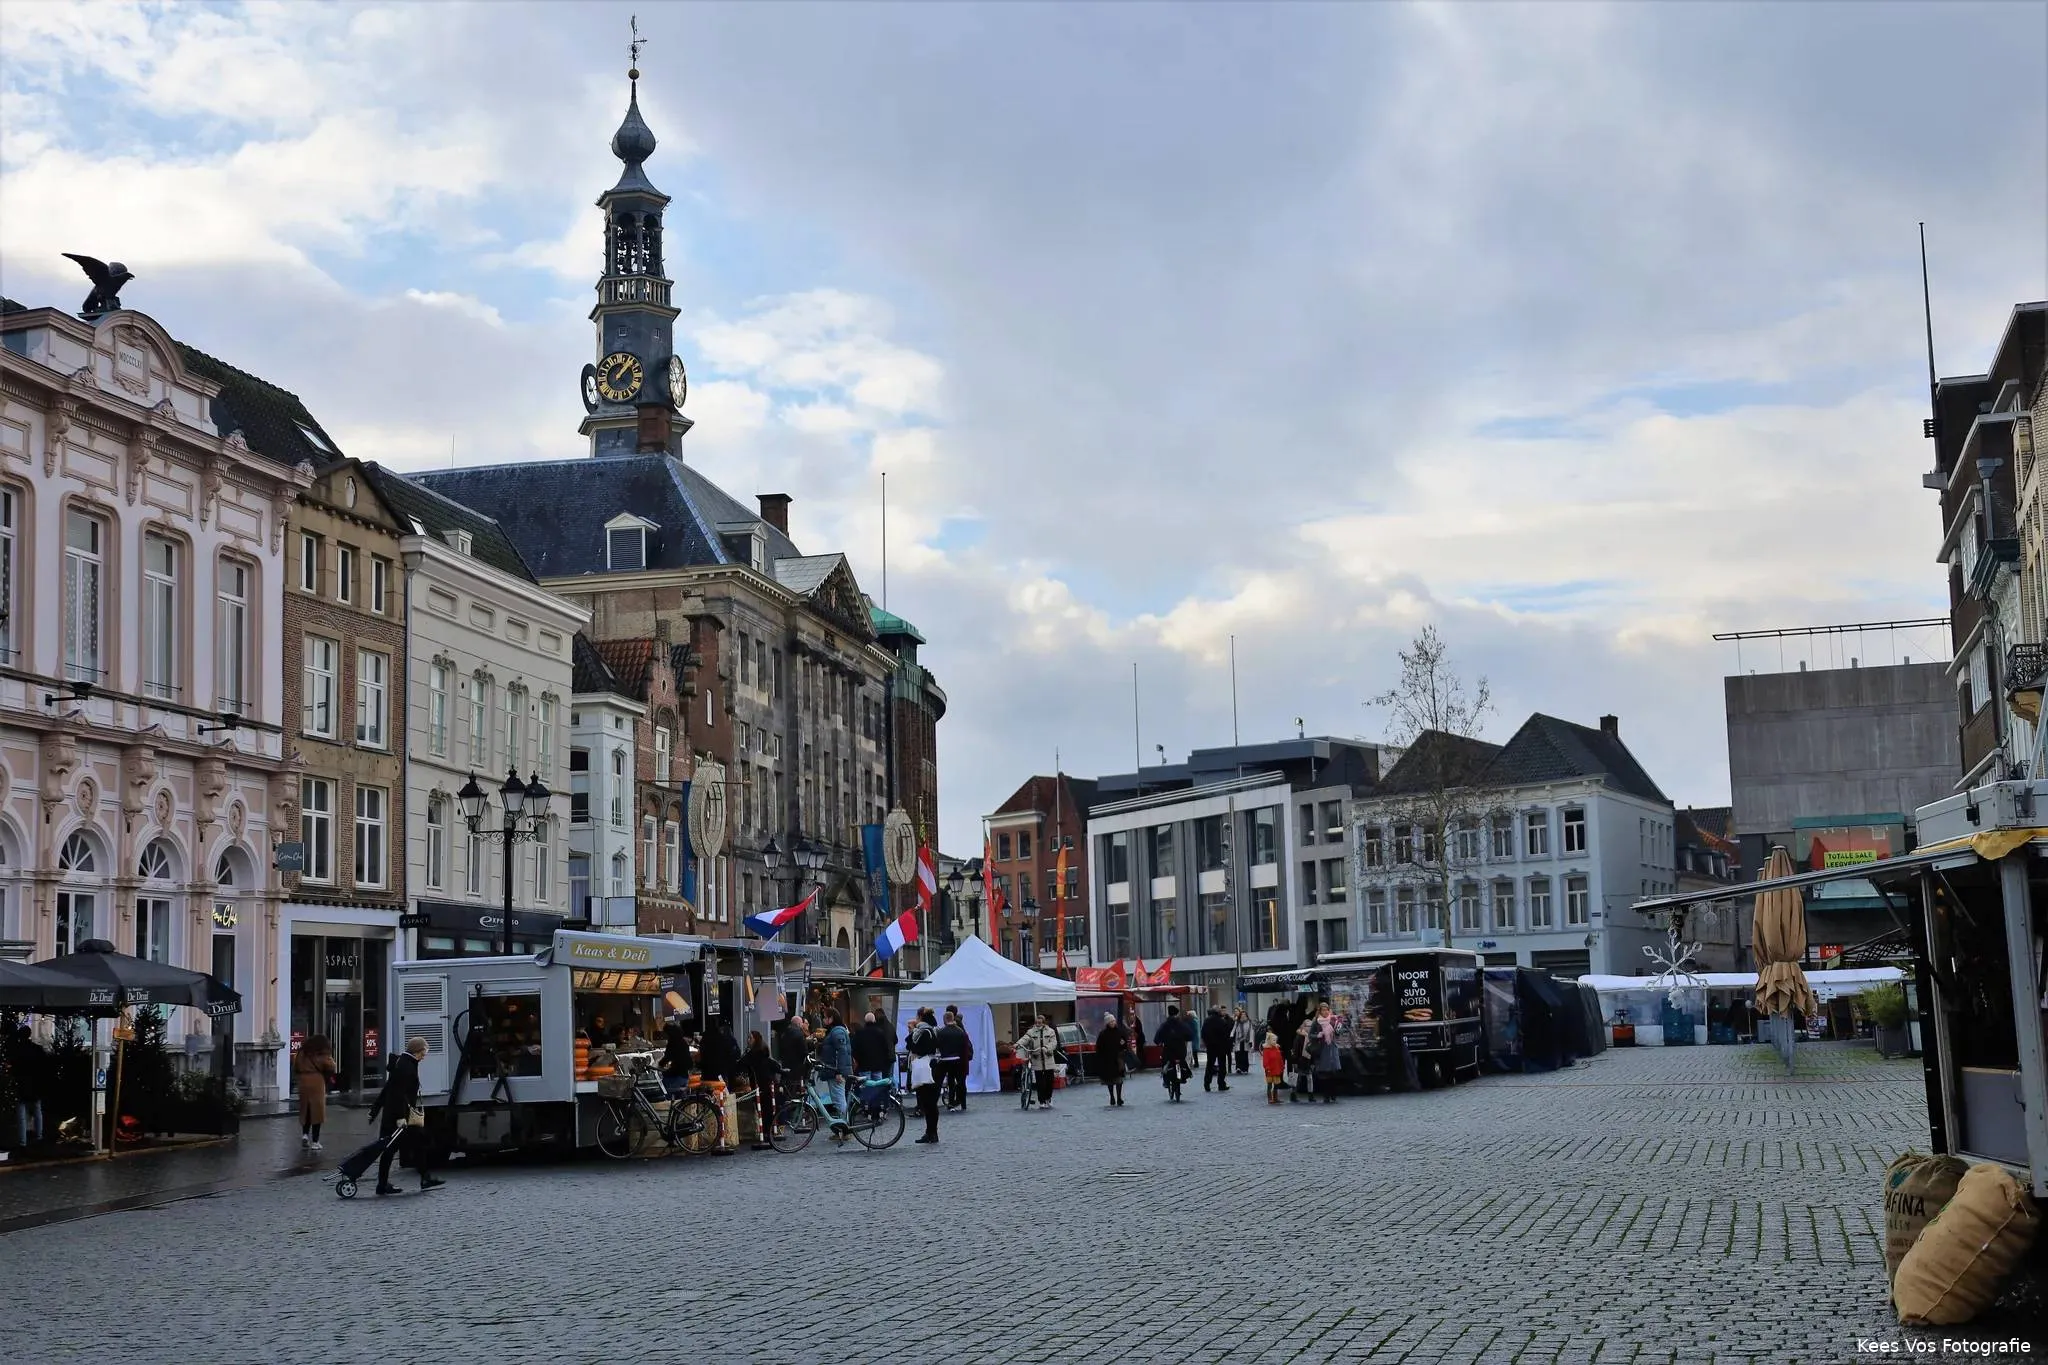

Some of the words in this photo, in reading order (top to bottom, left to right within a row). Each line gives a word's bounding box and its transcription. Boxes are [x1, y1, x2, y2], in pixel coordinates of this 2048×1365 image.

[1855, 851, 1873, 859] SALE
[575, 943, 605, 955] Kaas
[608, 948, 616, 958] &
[622, 948, 647, 961] Deli
[1398, 971, 1429, 980] NOORT
[1209, 977, 1225, 985] ZARA
[1411, 980, 1418, 988] &
[1404, 988, 1426, 997] SUYD
[1400, 997, 1430, 1006] NOTEN
[212, 1001, 237, 1014] Druif
